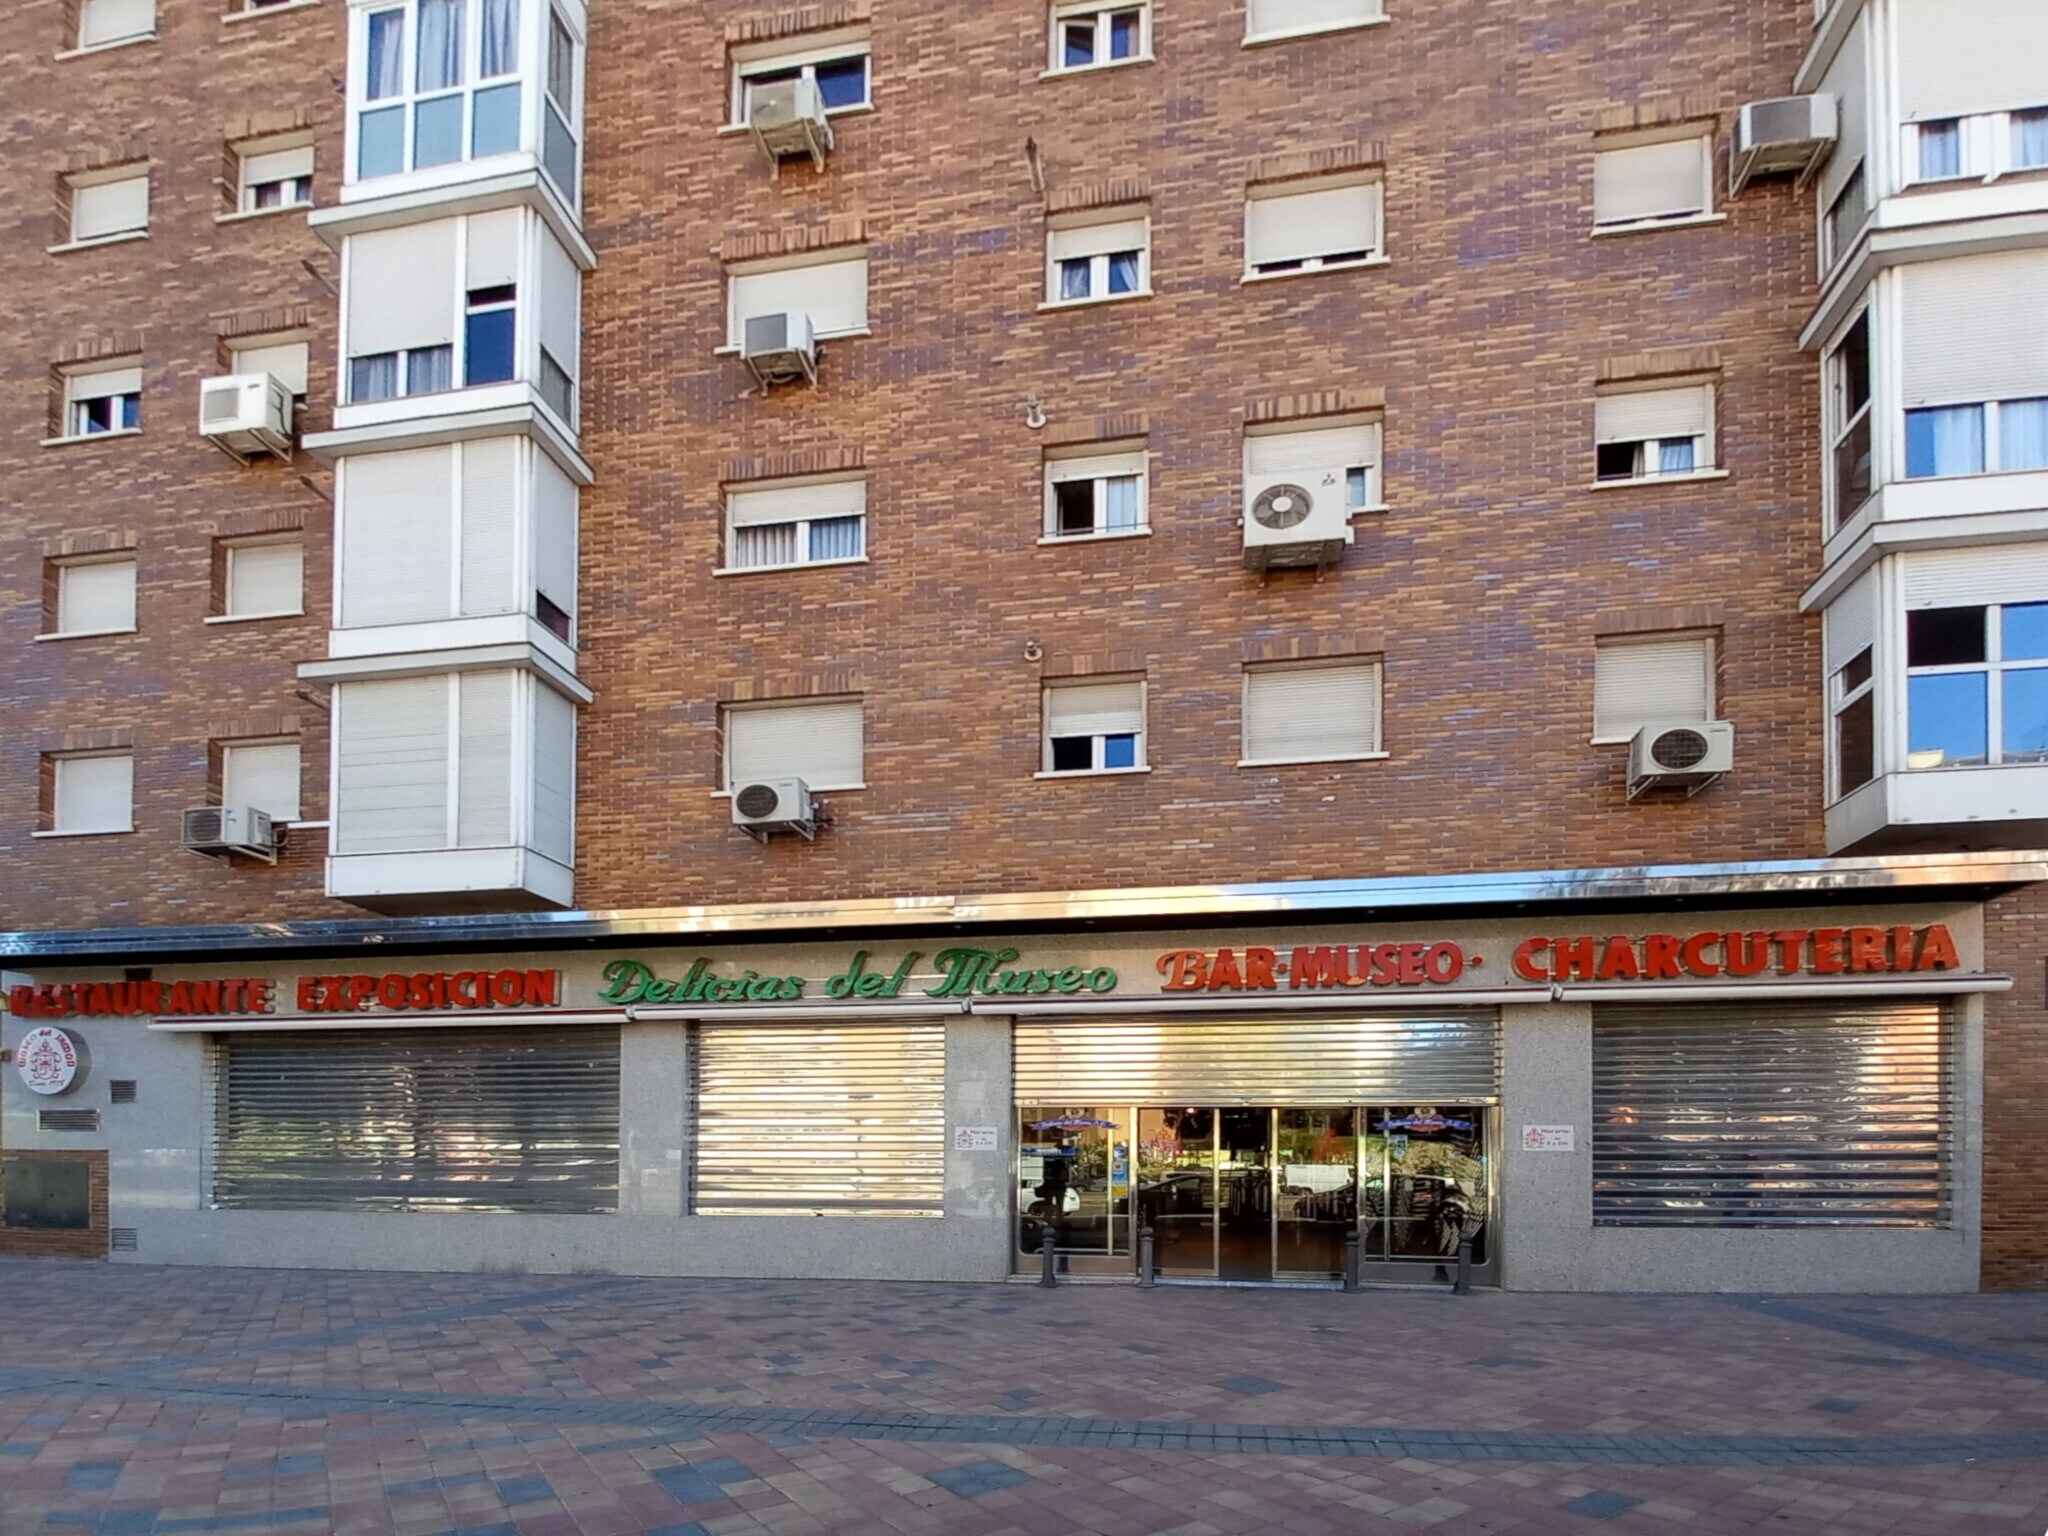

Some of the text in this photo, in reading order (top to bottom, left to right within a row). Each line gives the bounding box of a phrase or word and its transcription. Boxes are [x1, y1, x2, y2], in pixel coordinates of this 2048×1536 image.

[598, 947, 1118, 1004] Delicias del Museo
[1513, 924, 1960, 981] CHARCUTERIA
[10, 968, 557, 1017] RESTAURANTE EXPOSICION
